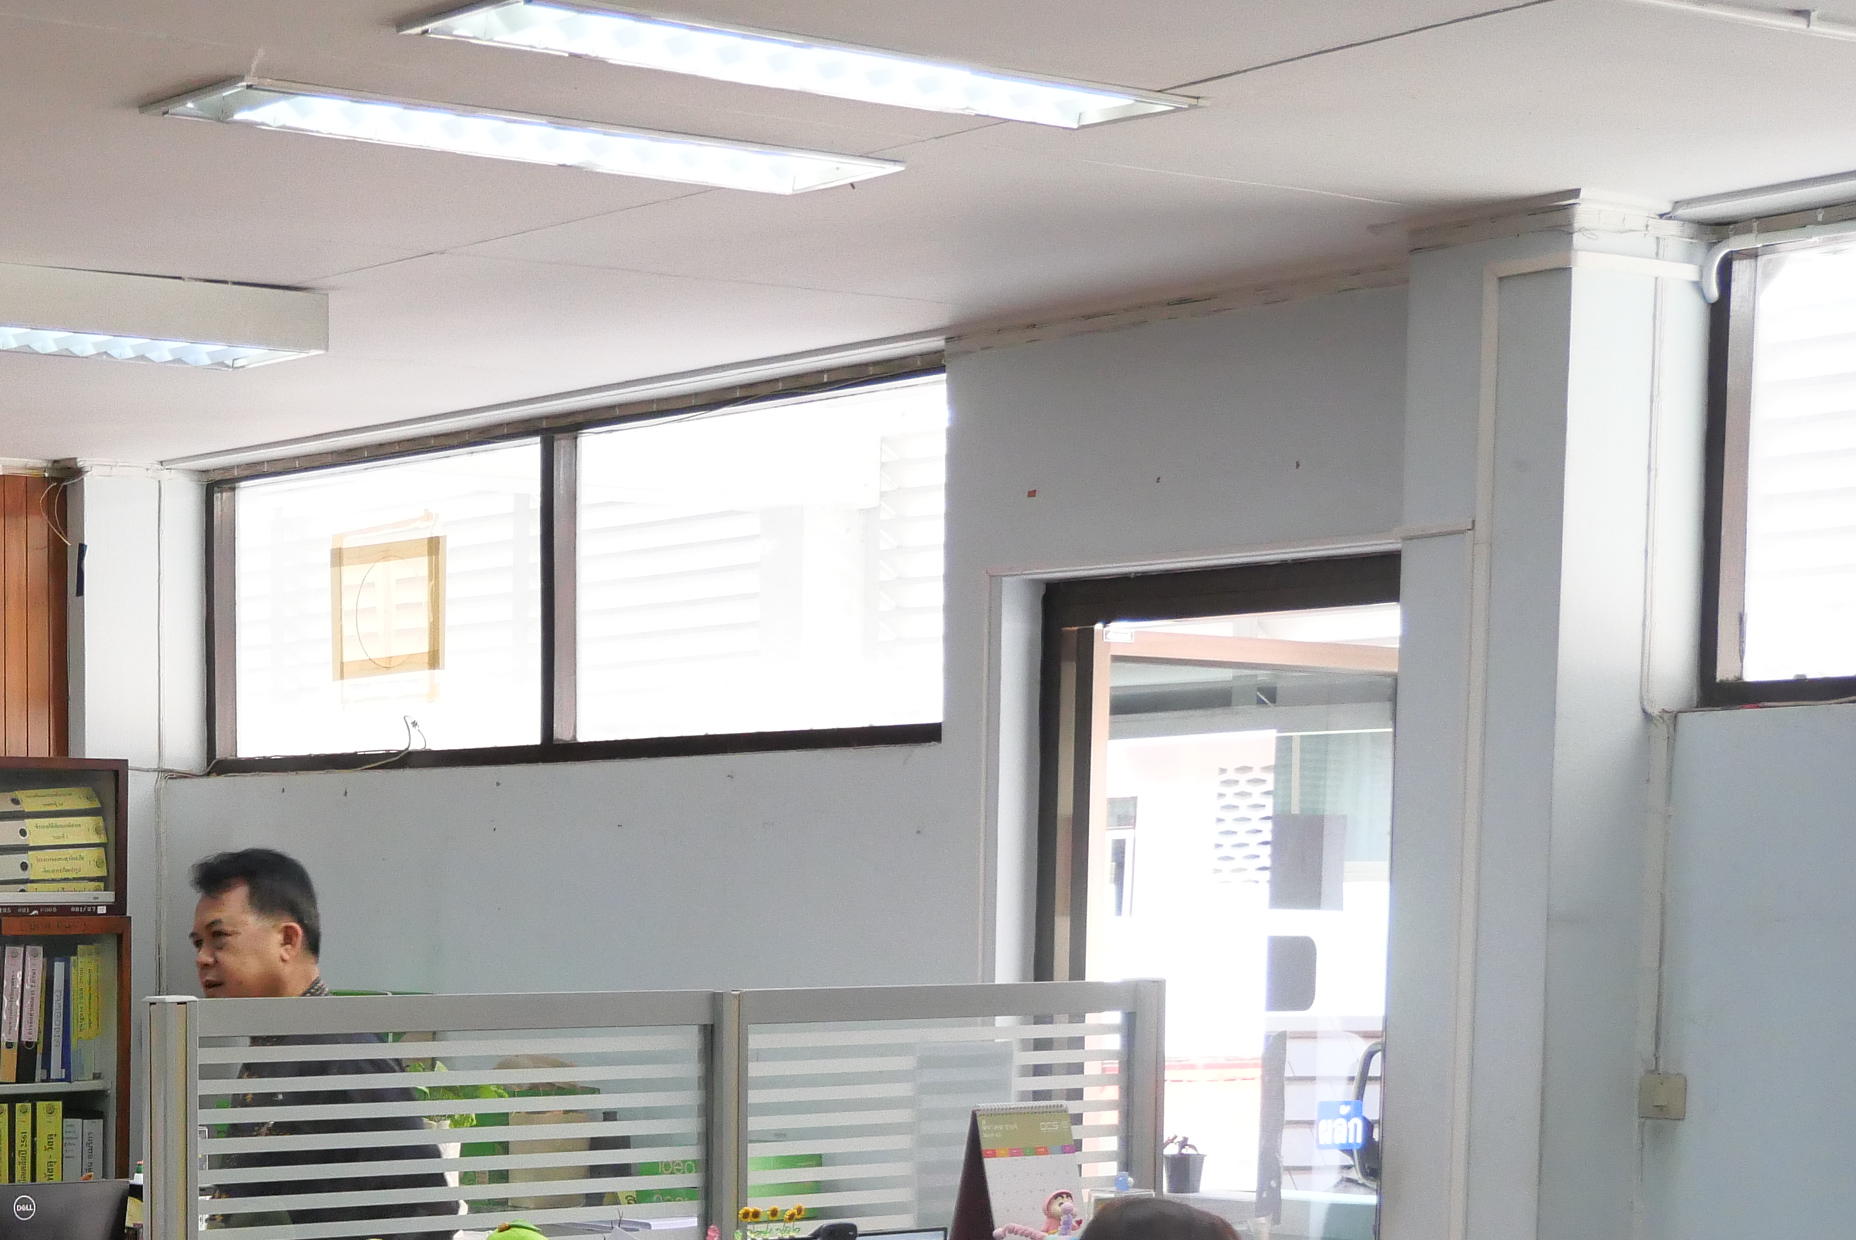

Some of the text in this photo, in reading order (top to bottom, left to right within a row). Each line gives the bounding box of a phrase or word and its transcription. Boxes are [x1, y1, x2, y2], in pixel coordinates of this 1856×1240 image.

[20, 1131, 28, 1149] 2561
[43, 1133, 58, 1152] วัสดุ
[43, 1160, 58, 1182] พัสดุ
[16, 1203, 34, 1212] DELL
